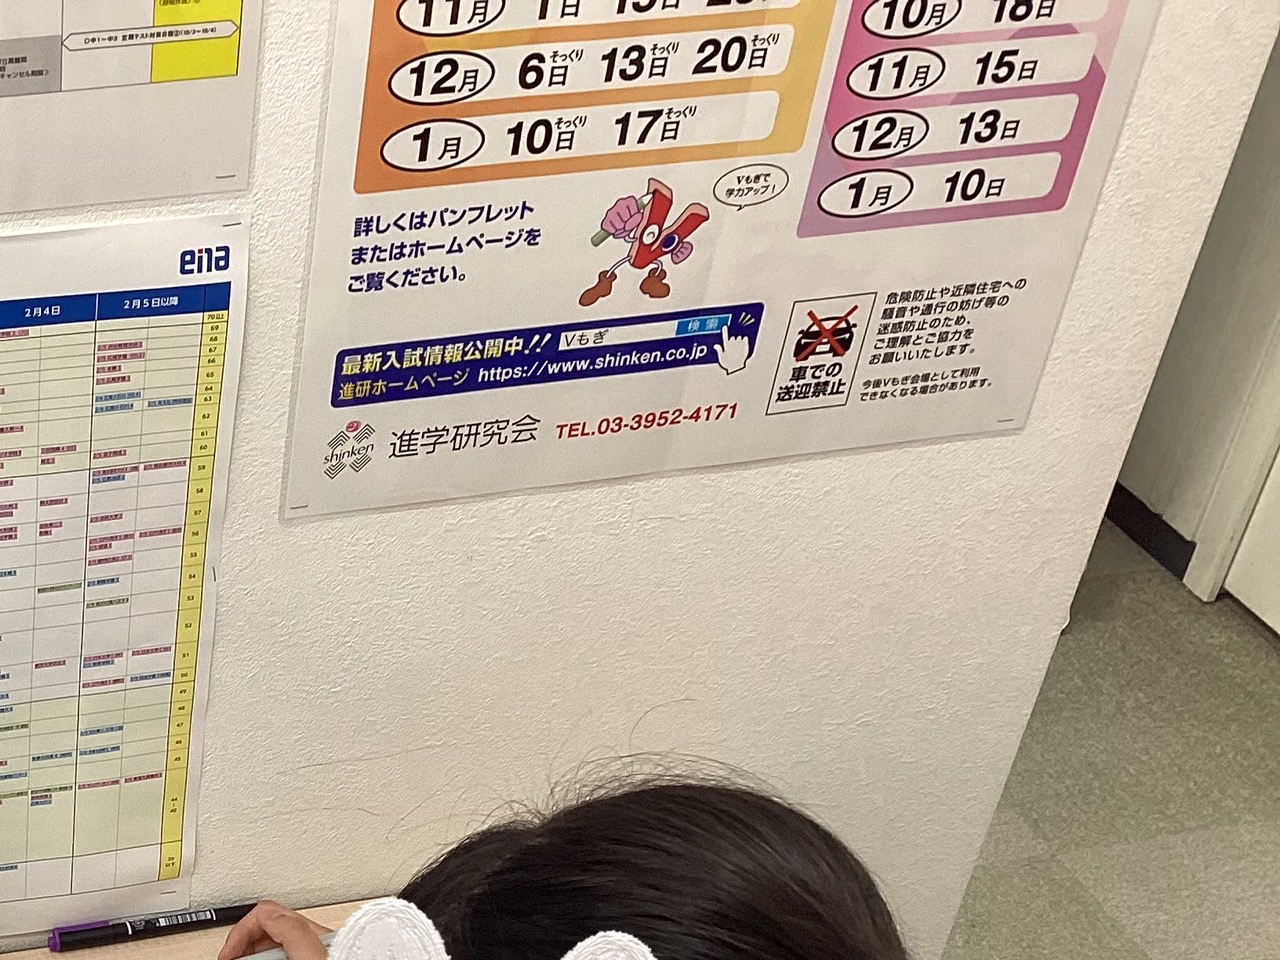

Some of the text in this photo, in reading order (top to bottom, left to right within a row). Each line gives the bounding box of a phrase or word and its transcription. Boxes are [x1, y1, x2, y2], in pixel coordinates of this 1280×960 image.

[651, 42, 680, 55] そっくり
[751, 33, 780, 47] そっくり
[409, 36, 768, 97] 12月 6日 13日 20日
[550, 49, 584, 63] そっくり
[868, 49, 1038, 92] 11月 15日
[554, 115, 587, 129] そっくり
[665, 105, 697, 119] そっくり
[413, 109, 680, 162] 1月 10日 17日
[852, 109, 1021, 153] 12月 13日
[736, 173, 771, 185] Vもぎで
[848, 168, 1005, 209] 1月 10日
[354, 201, 536, 238] 詳しくはパンフレット
[351, 227, 542, 265] またはホームページを
[180, 245, 231, 275] ena
[348, 266, 466, 293] ご覧ください。
[885, 278, 1027, 305] 危険防止や近隣住宅への
[24, 305, 61, 318] 2月4日
[123, 296, 179, 309] 2月5日以降
[881, 295, 1009, 320] 騒音や通行の妨げ等の
[564, 329, 609, 347] Vもぎ
[687, 319, 719, 331] 検索
[873, 328, 974, 350] ご理解とご協力を
[869, 345, 975, 365] お願いいたします。
[338, 343, 708, 401] 進研ホームページ https://www.shinken.co.jp
[789, 362, 842, 382] 車での
[775, 379, 846, 403] 送迎禁止
[860, 378, 992, 402] できなくなる場合があります。
[389, 403, 738, 459] 進学研究会 TEL.03-3952-4171
[323, 442, 374, 464] shinken
